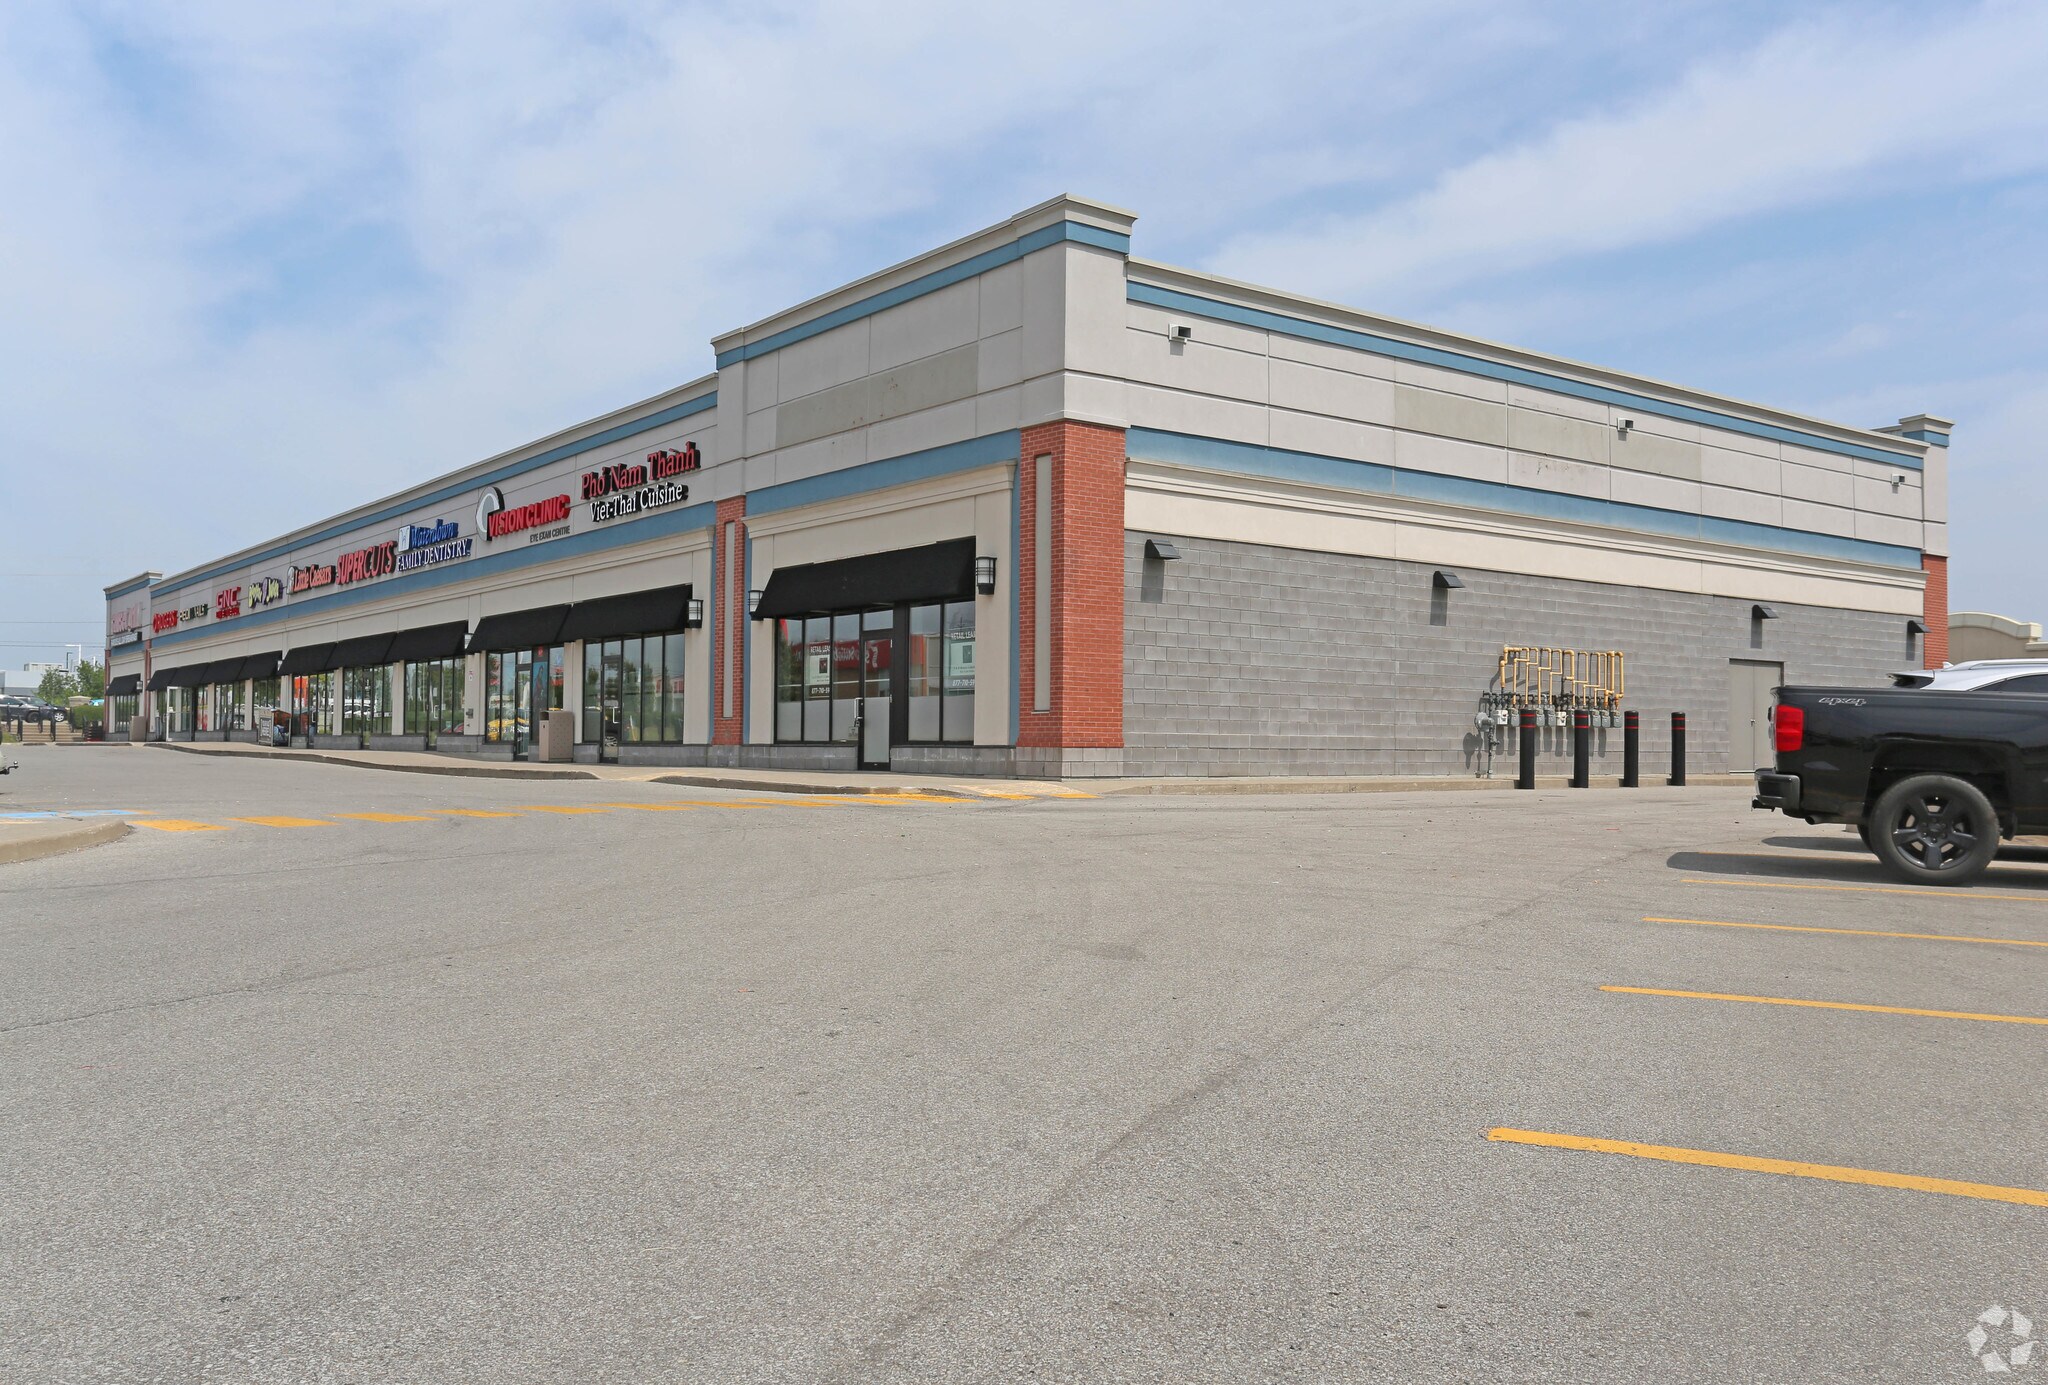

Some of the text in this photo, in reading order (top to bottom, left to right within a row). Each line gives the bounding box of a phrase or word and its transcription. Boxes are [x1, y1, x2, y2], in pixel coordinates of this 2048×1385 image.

[610, 463, 646, 492] Nam
[489, 494, 571, 538] VISION CLINIC
[590, 482, 686, 521] Viet-Thai Cuisine
[530, 533, 538, 543] EYE
[552, 525, 570, 538] CENTRE
[336, 540, 397, 585] SUPERCUTS
[397, 538, 472, 572] FAMILY DENTISTRY
[216, 586, 241, 609] GNC
